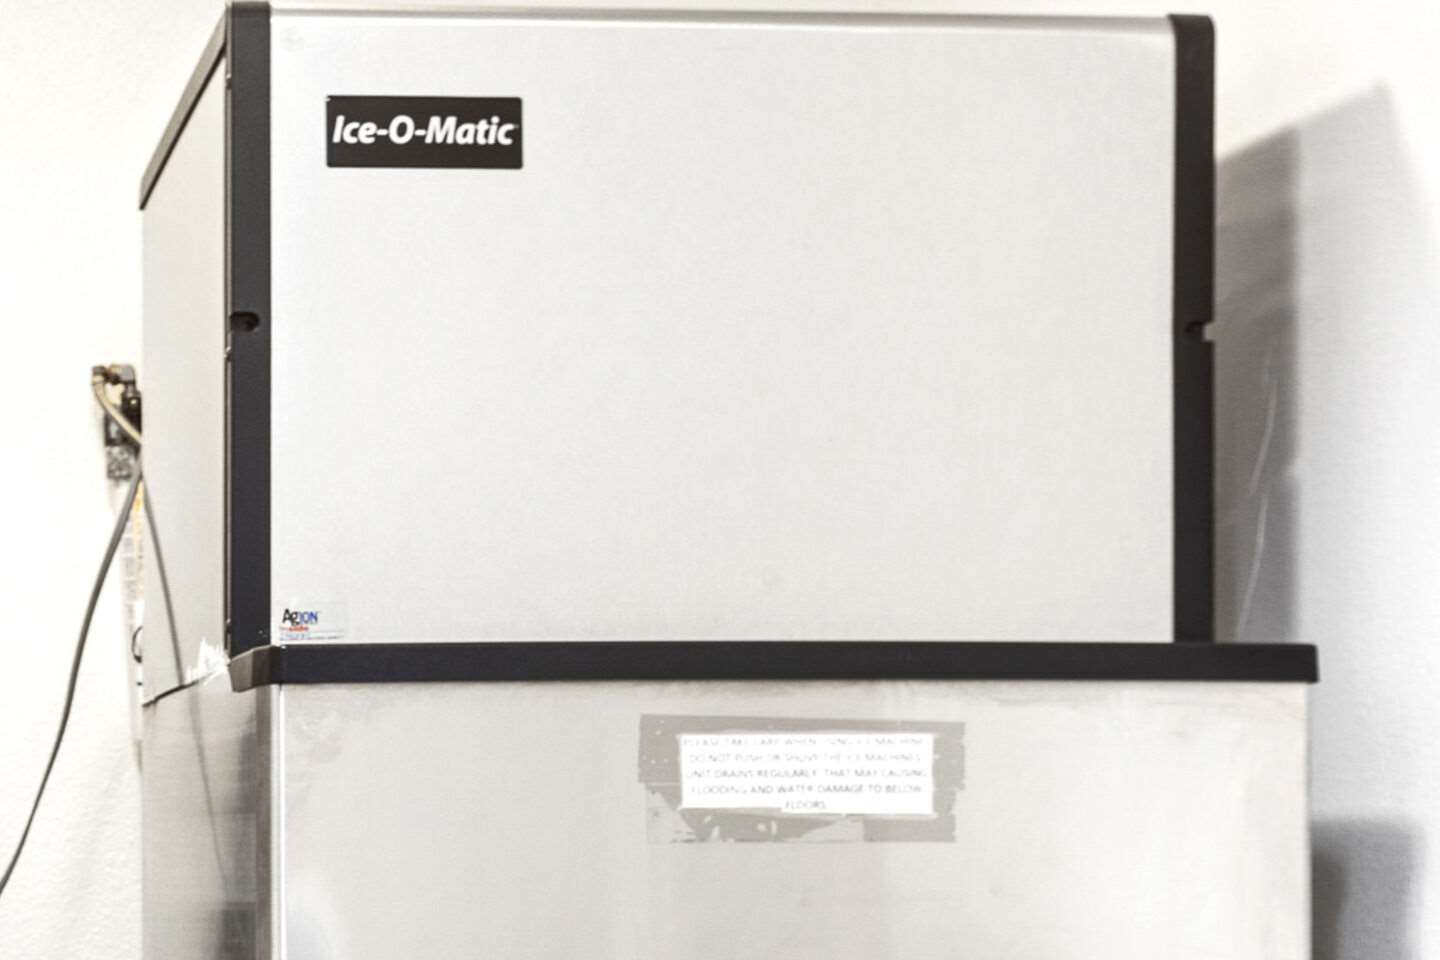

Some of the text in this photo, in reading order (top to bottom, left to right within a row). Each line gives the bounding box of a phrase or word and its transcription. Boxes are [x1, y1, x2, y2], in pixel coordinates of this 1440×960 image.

[331, 114, 516, 146] Ice-O-Matic
[750, 783, 774, 795] AND
[776, 783, 814, 795] WATER
[816, 783, 864, 795] DAMAGE
[867, 783, 884, 795] TO
